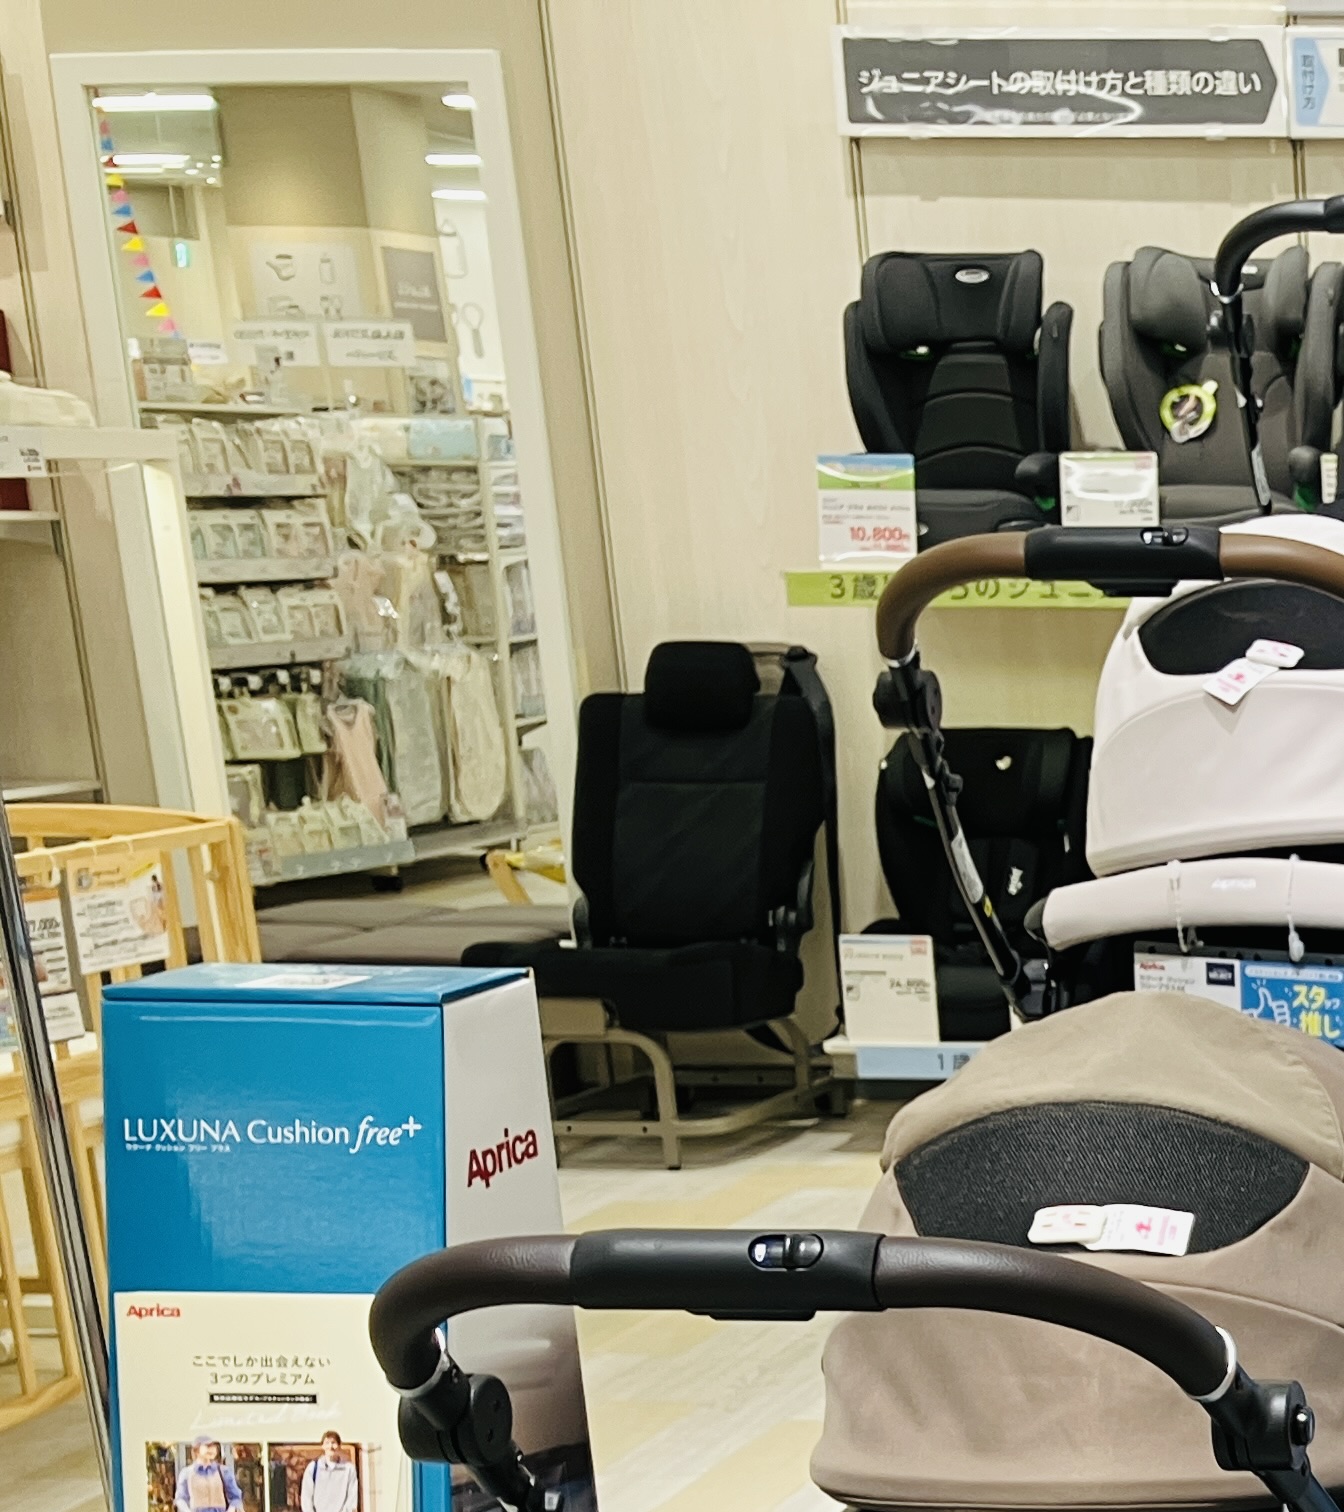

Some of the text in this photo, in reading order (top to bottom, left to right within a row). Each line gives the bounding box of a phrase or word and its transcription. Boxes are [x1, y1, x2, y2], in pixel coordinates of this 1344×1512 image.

[123, 1115, 423, 1154] LUXUNA Cushion free+
[466, 1127, 539, 1189] Aprica
[126, 1303, 181, 1321] Aprica
